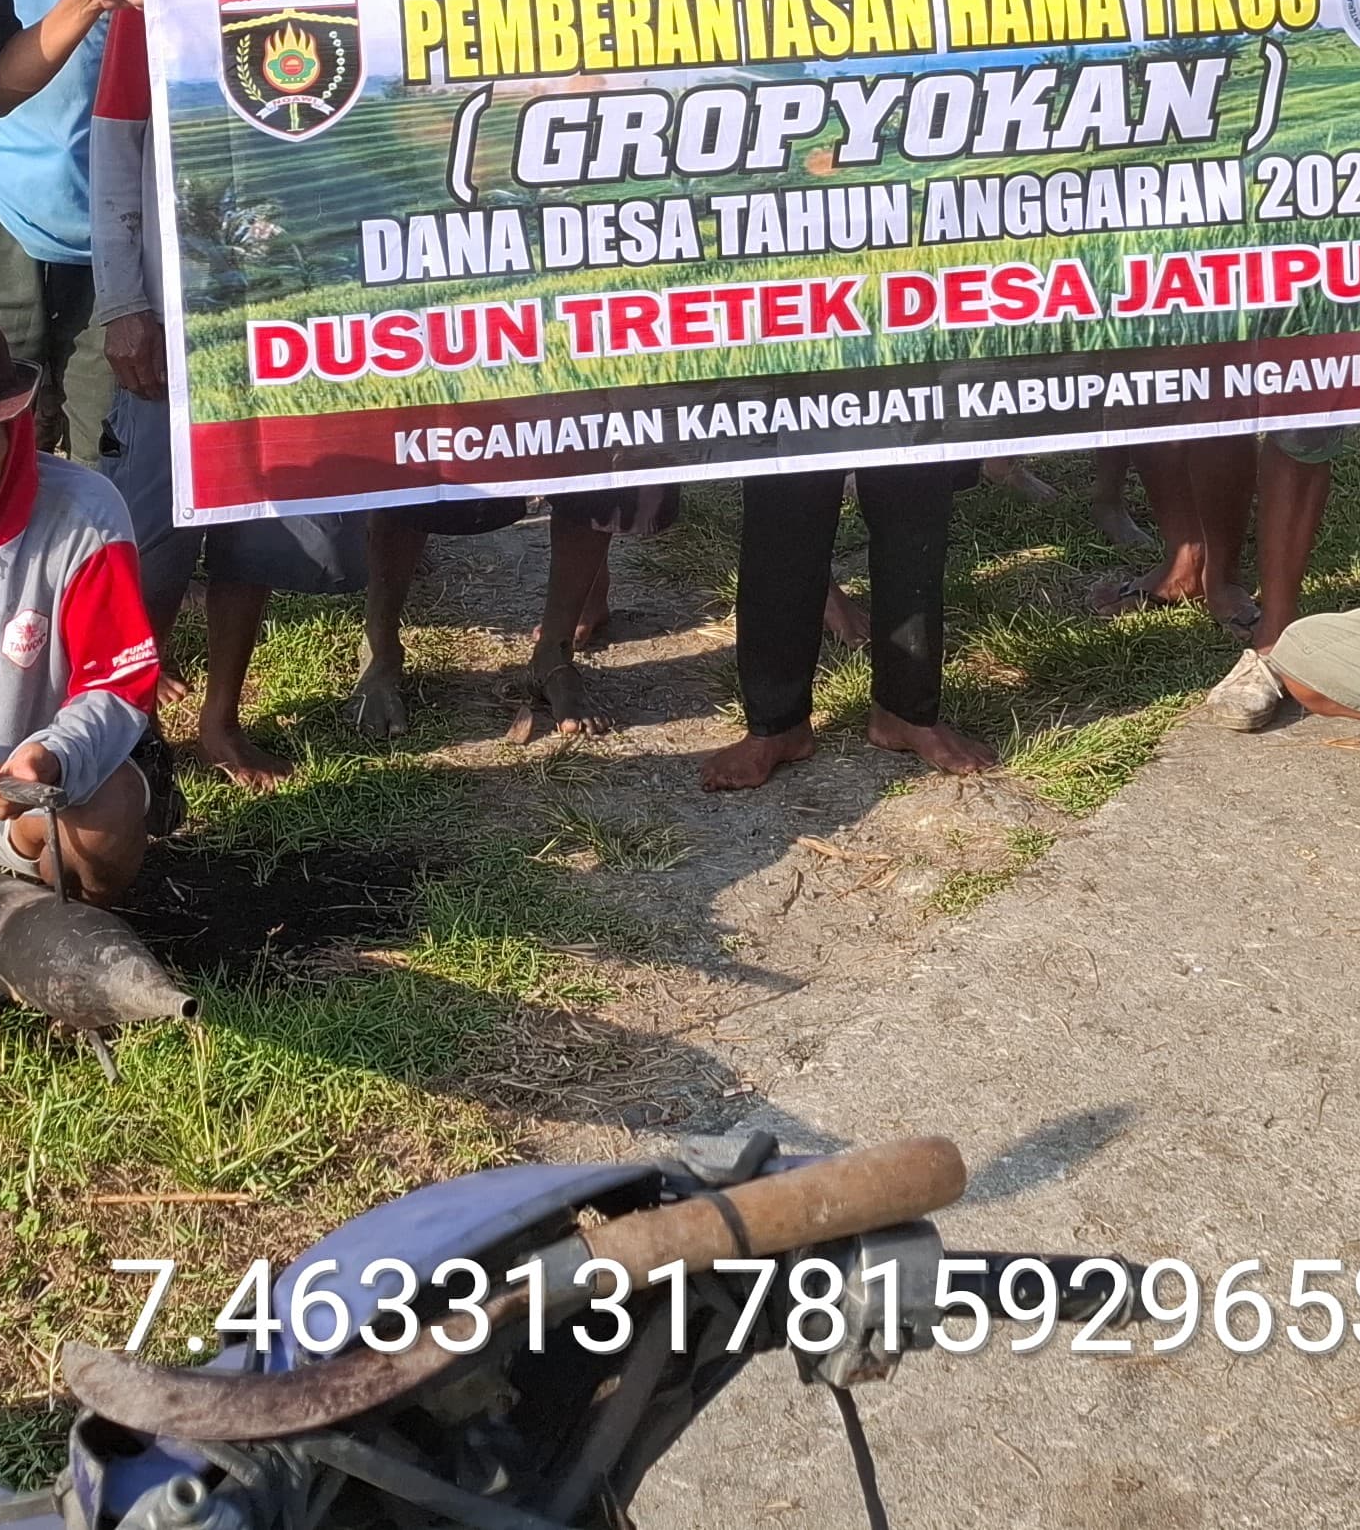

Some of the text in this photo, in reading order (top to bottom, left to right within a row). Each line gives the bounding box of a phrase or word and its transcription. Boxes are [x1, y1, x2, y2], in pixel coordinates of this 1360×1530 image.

[360, 207, 532, 285] DANA
[541, 199, 701, 269] DESA
[709, 182, 910, 257] TAHUN
[922, 158, 1244, 243] ANGGARAN
[254, 305, 538, 380] DUSUN
[563, 280, 861, 354] TRETEK
[887, 263, 1096, 328] DESA
[394, 408, 664, 465] KECAMATAN
[676, 385, 946, 441] KARANGJATI
[957, 367, 1210, 418] KABUPATEN
